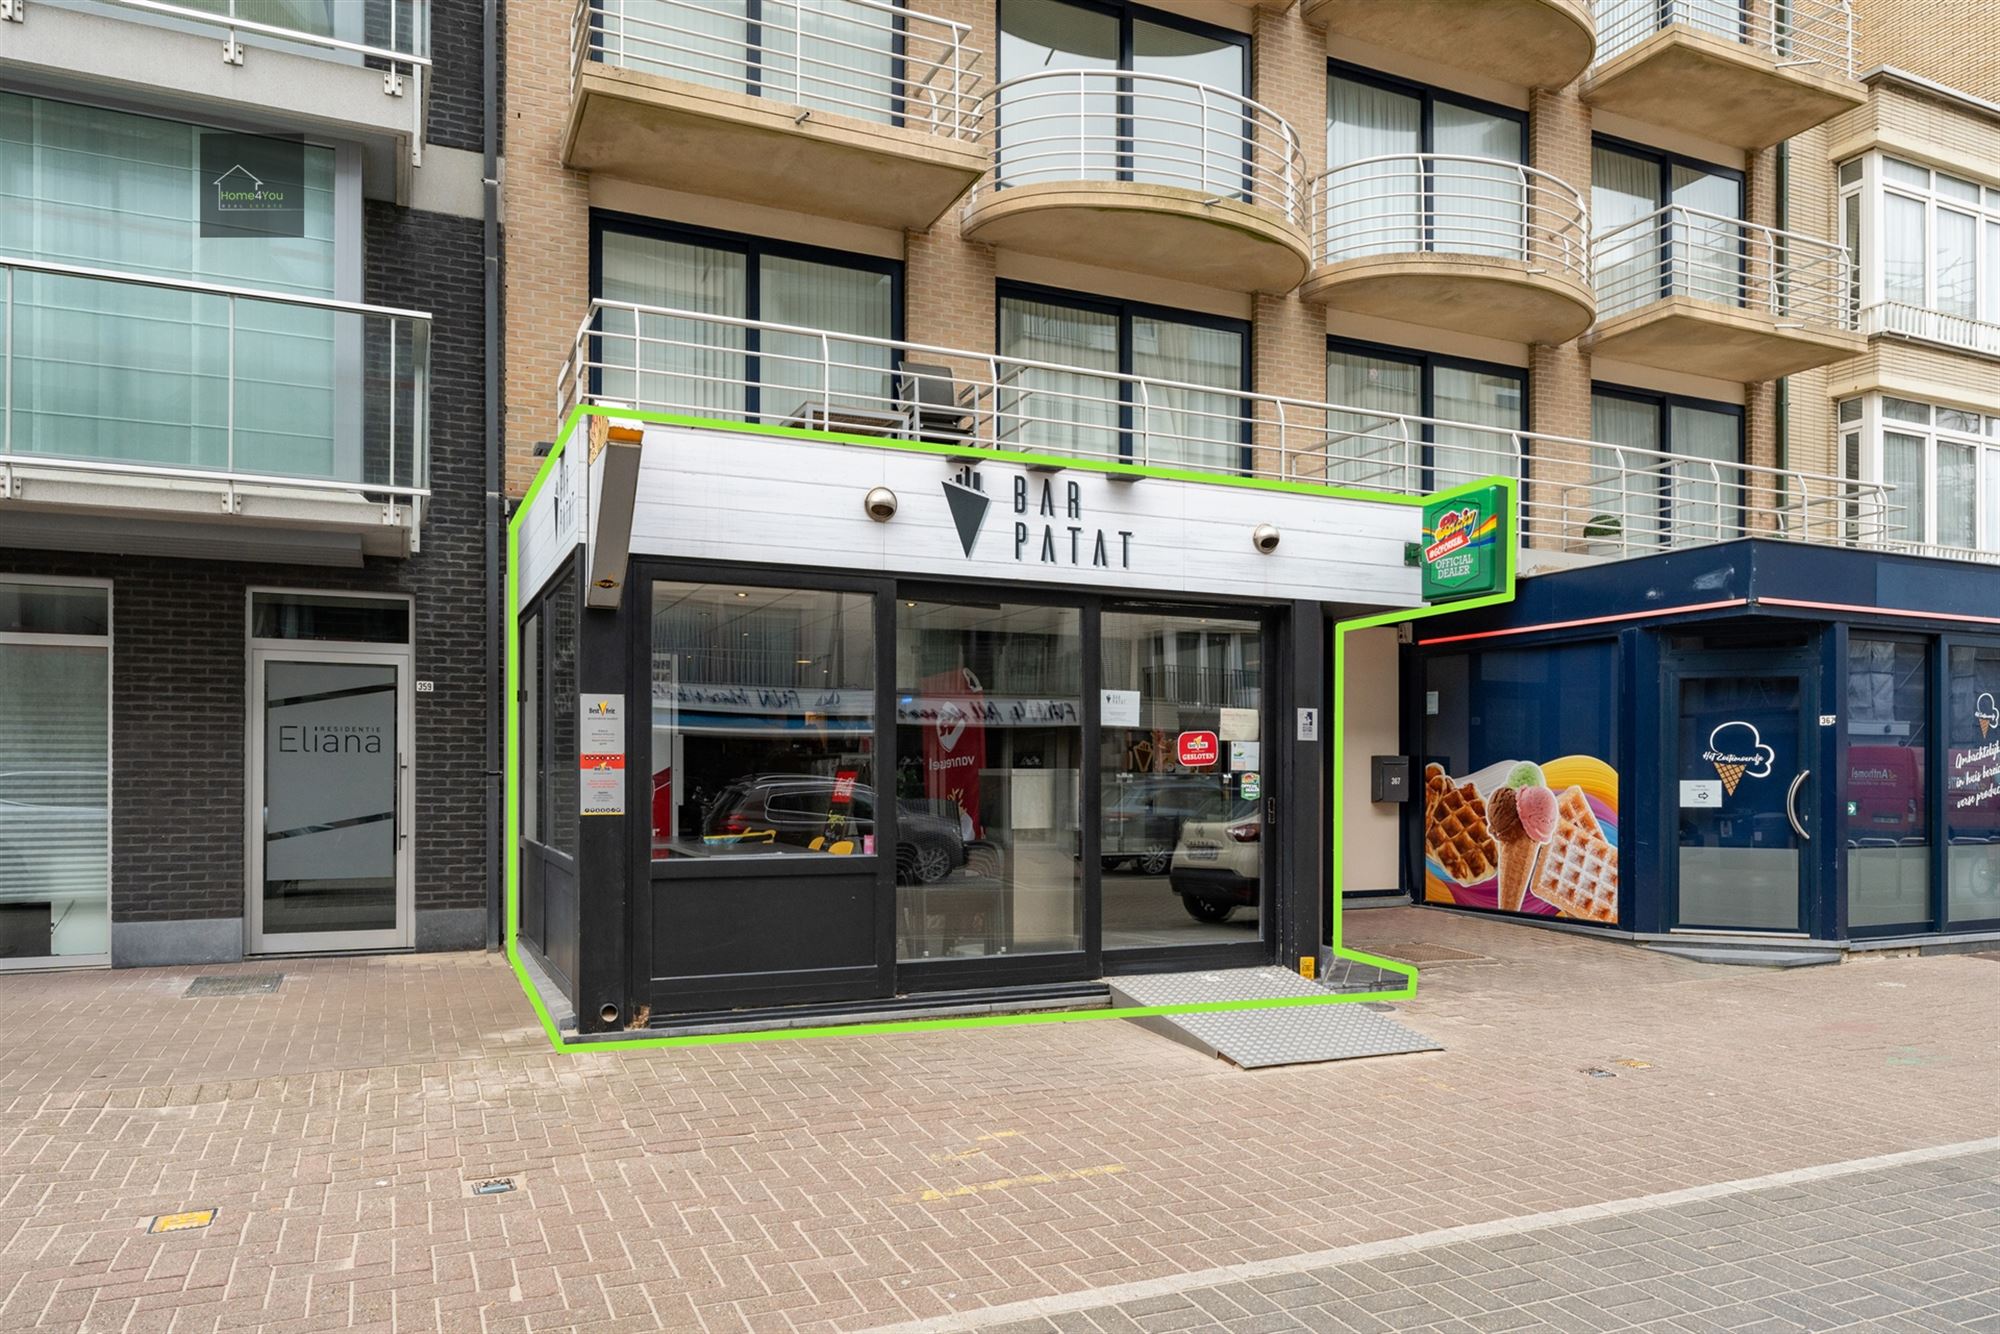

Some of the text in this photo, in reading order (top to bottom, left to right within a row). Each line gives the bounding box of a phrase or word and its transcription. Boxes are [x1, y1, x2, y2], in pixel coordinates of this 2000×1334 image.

[1014, 475, 1080, 518] BAR
[1015, 521, 1133, 568] PATAT
[1436, 554, 1473, 569] OFFICIAL
[1437, 565, 1471, 579] DEALER
[417, 682, 432, 691] 359
[279, 725, 381, 753] Eliana
[1182, 752, 1215, 761] GESLOTEN
